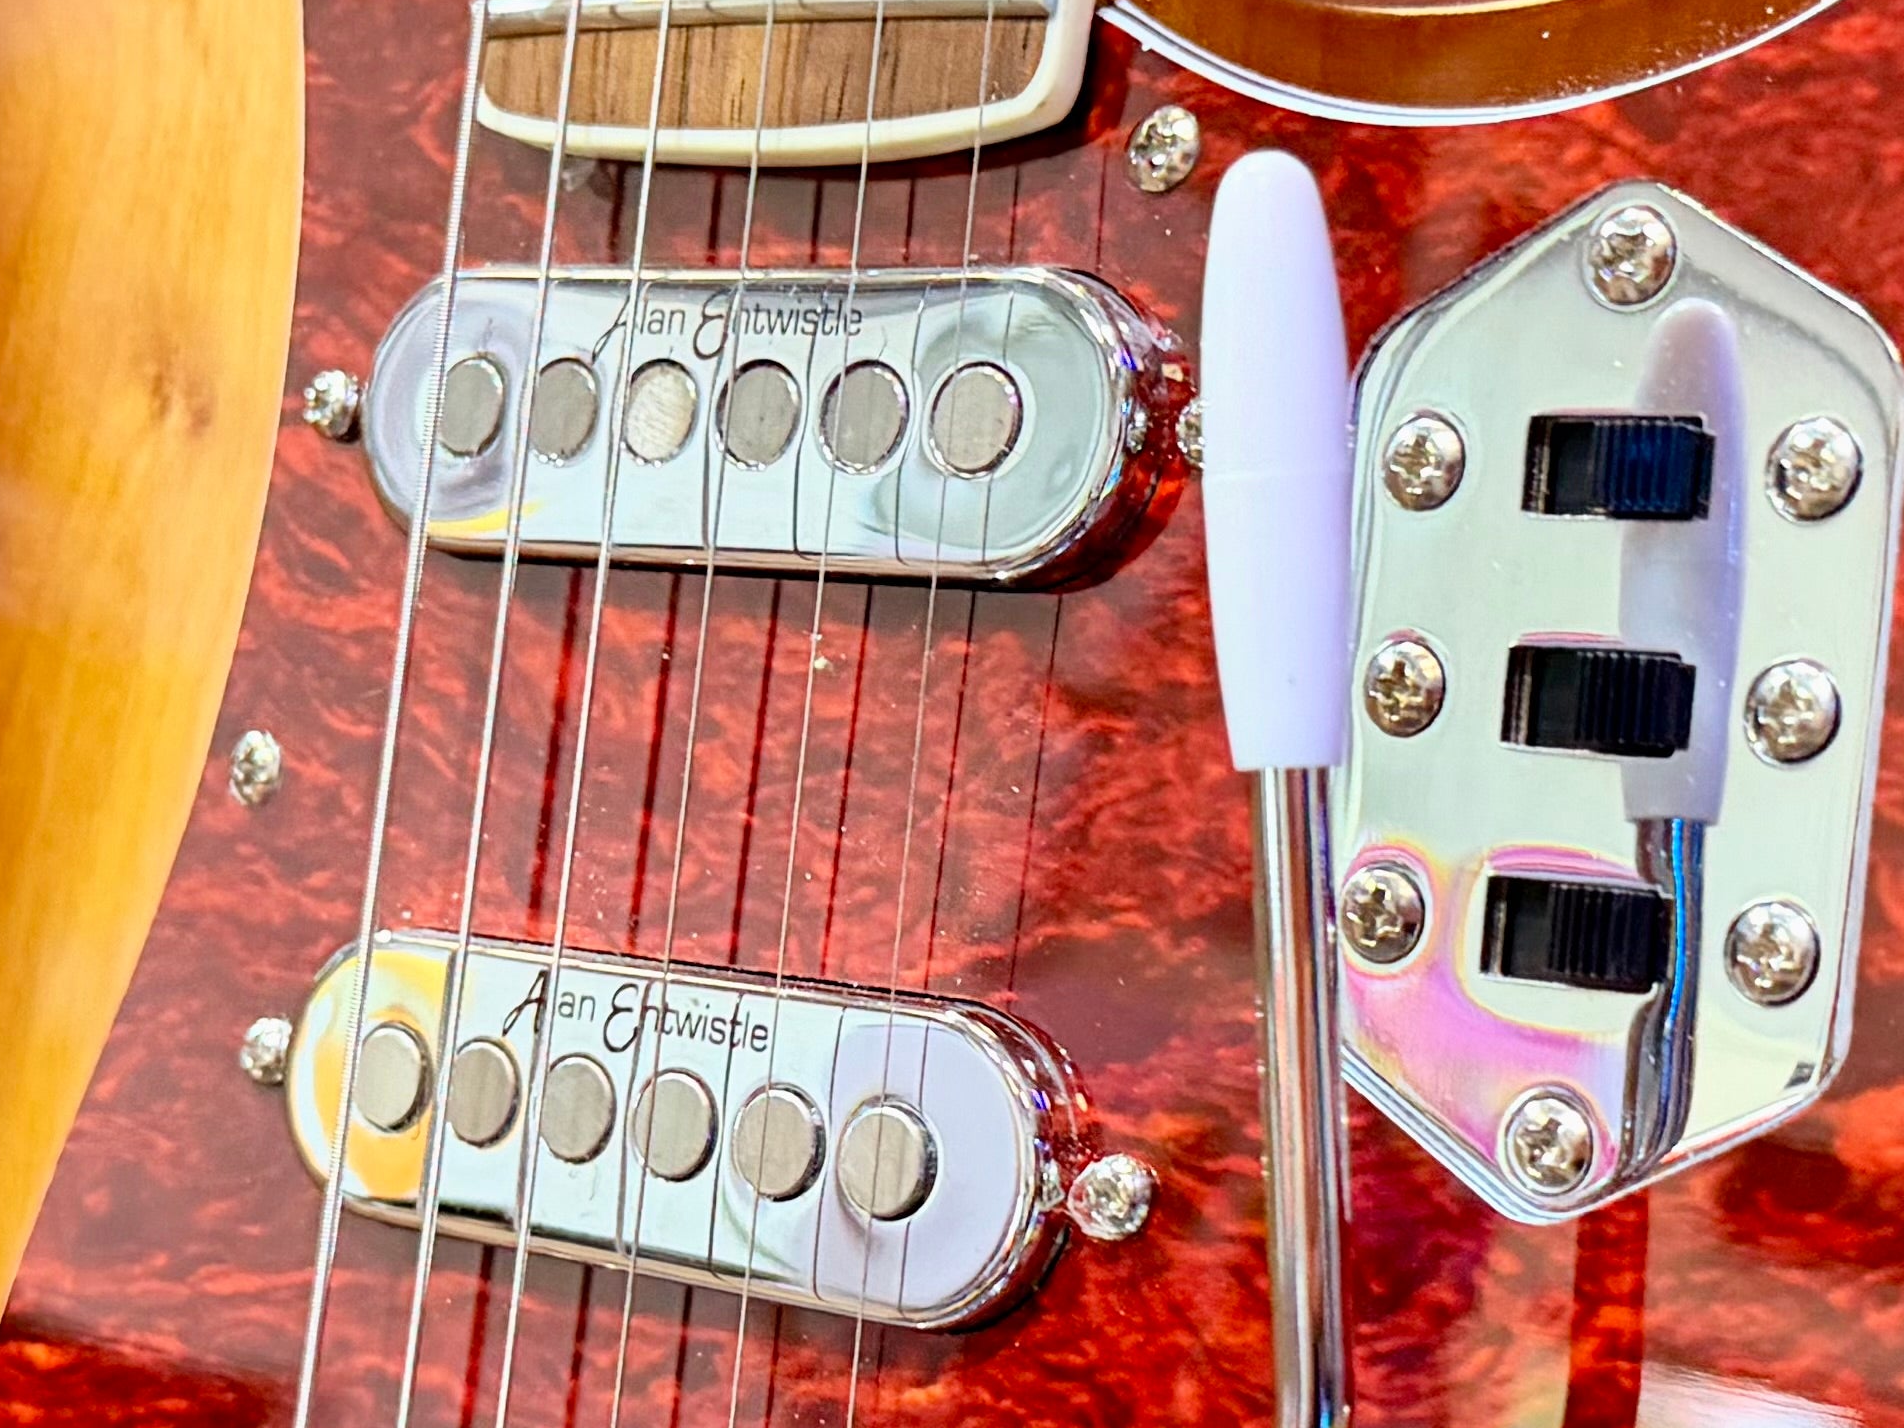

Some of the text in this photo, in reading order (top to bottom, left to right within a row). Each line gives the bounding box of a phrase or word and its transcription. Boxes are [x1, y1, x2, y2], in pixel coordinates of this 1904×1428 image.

[693, 286, 863, 361] Entwistle
[502, 968, 769, 1054] Aan Entwistle
